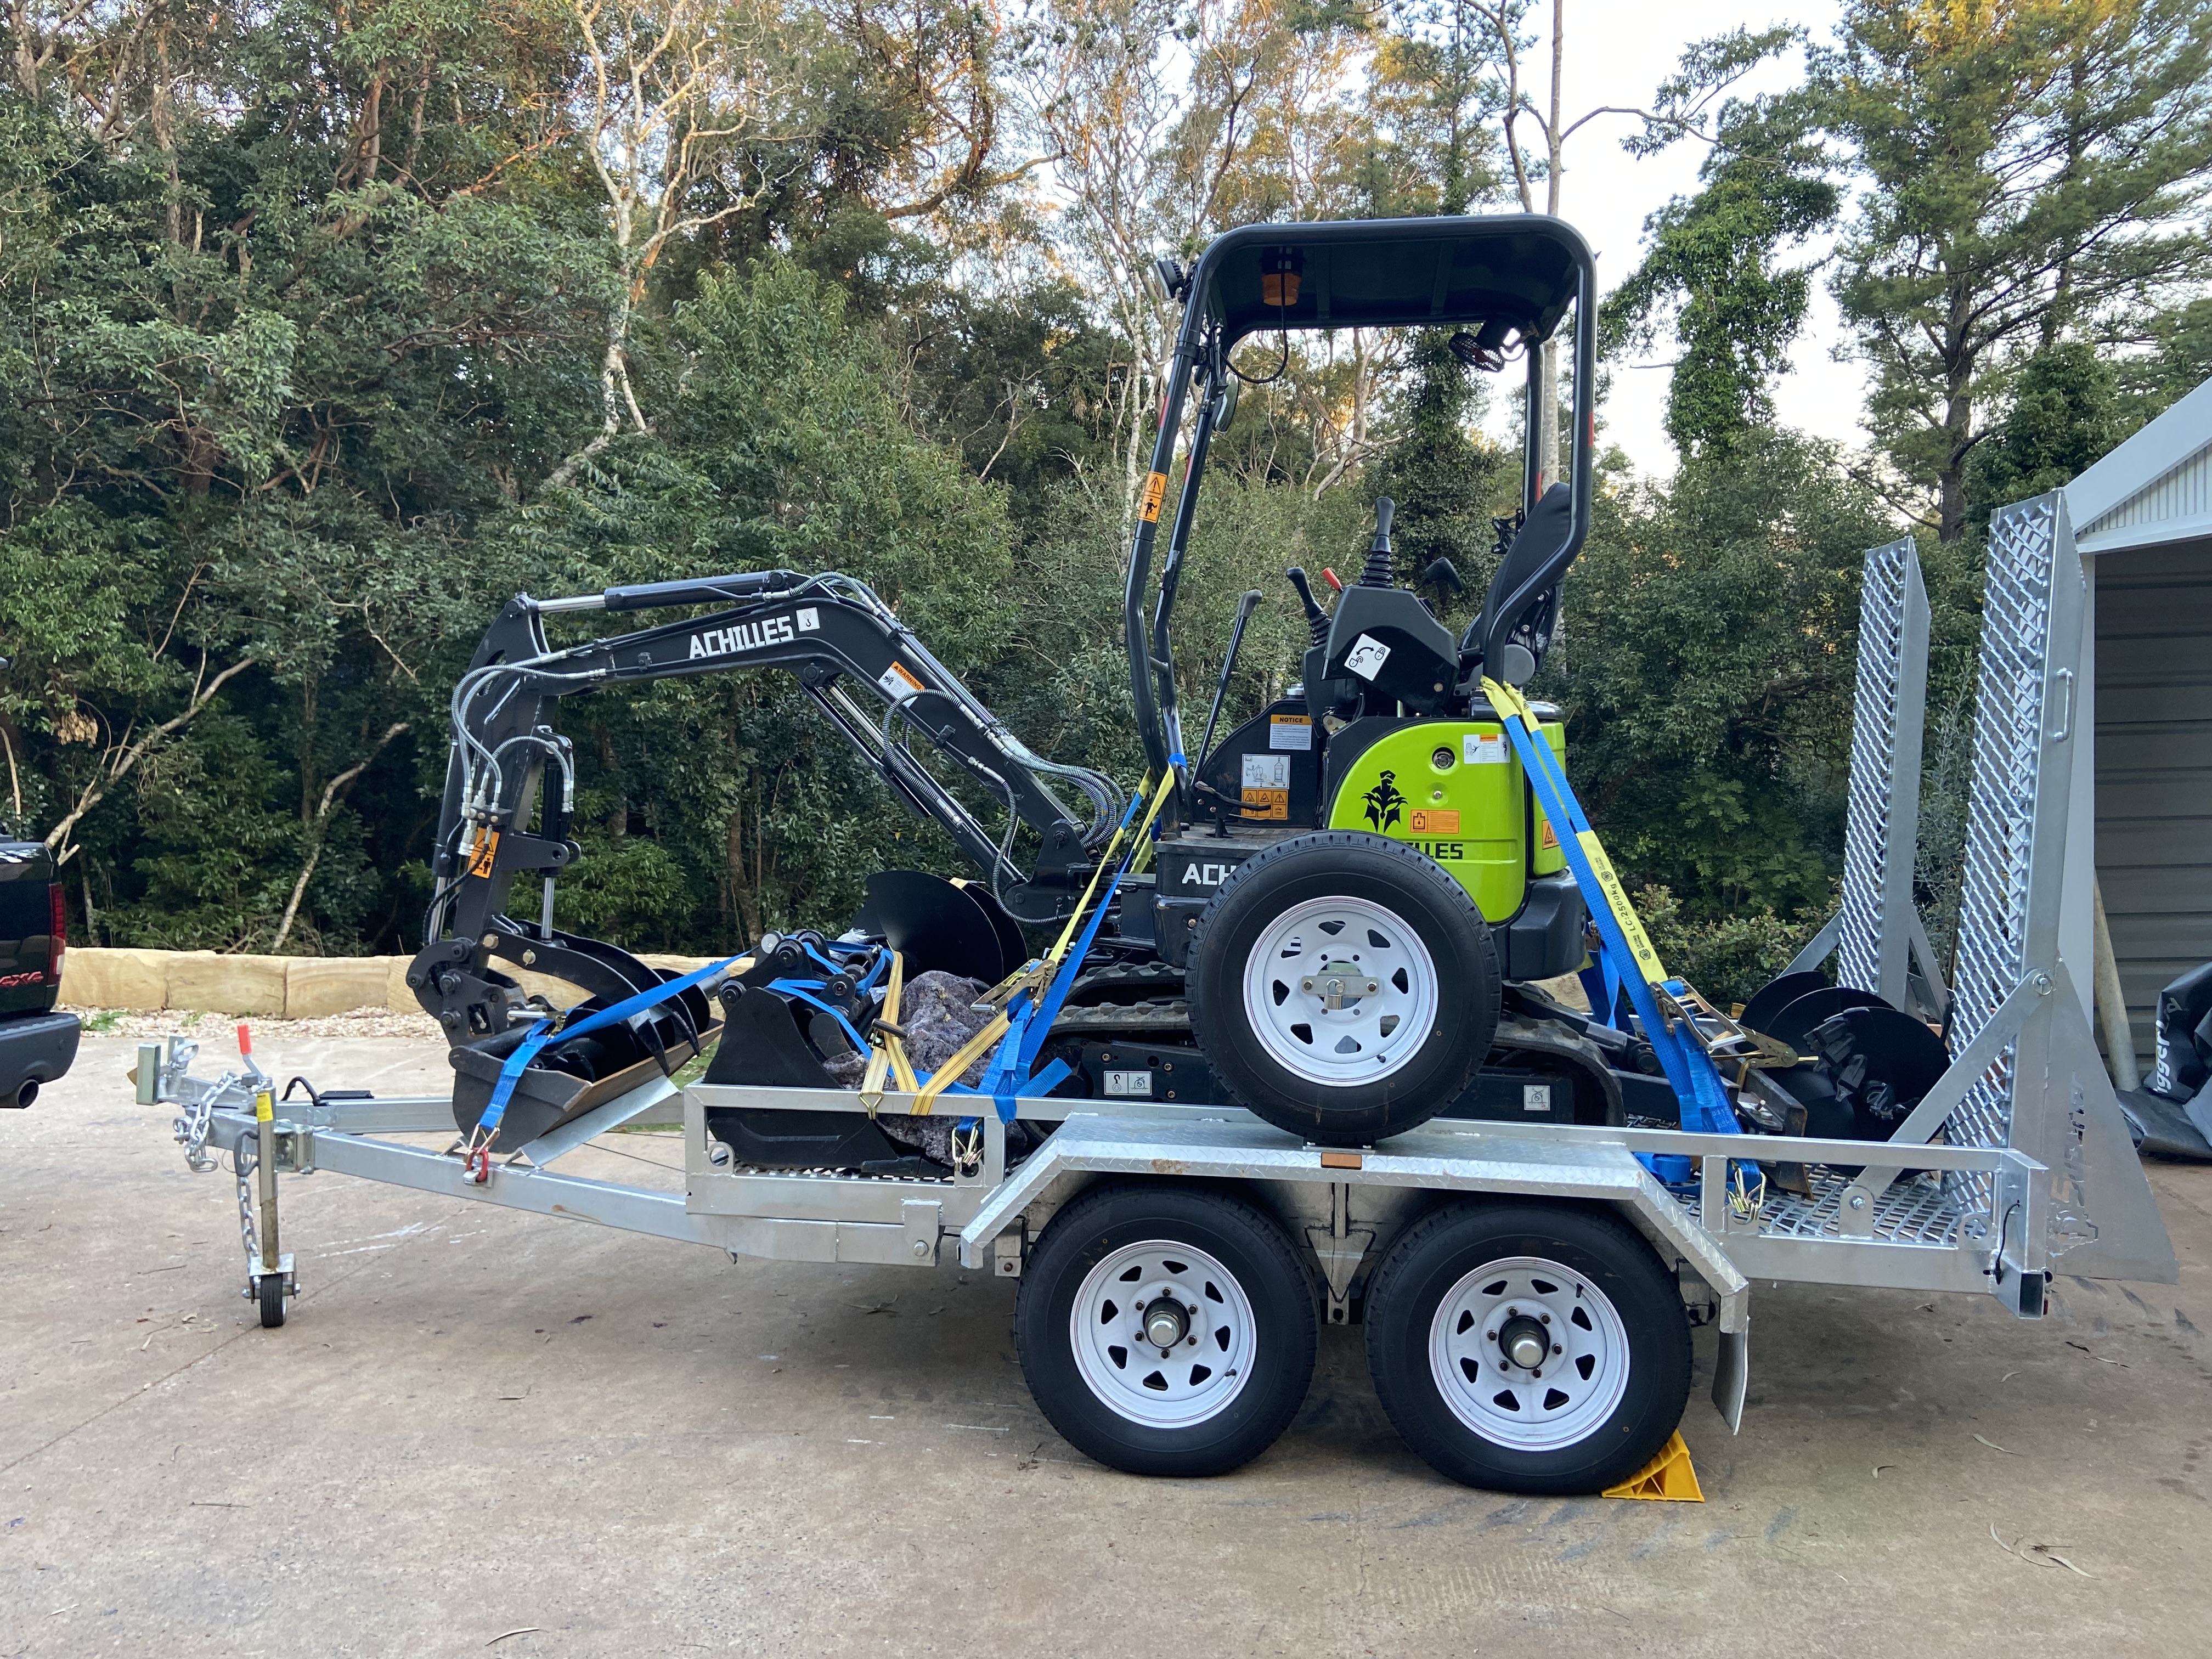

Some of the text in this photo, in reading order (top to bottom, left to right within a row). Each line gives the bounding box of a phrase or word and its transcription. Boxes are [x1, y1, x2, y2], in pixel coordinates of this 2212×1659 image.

[690, 616, 794, 659] ACHILLES
[898, 668, 921, 690] WARNING
[1182, 863, 1240, 885] ACH
